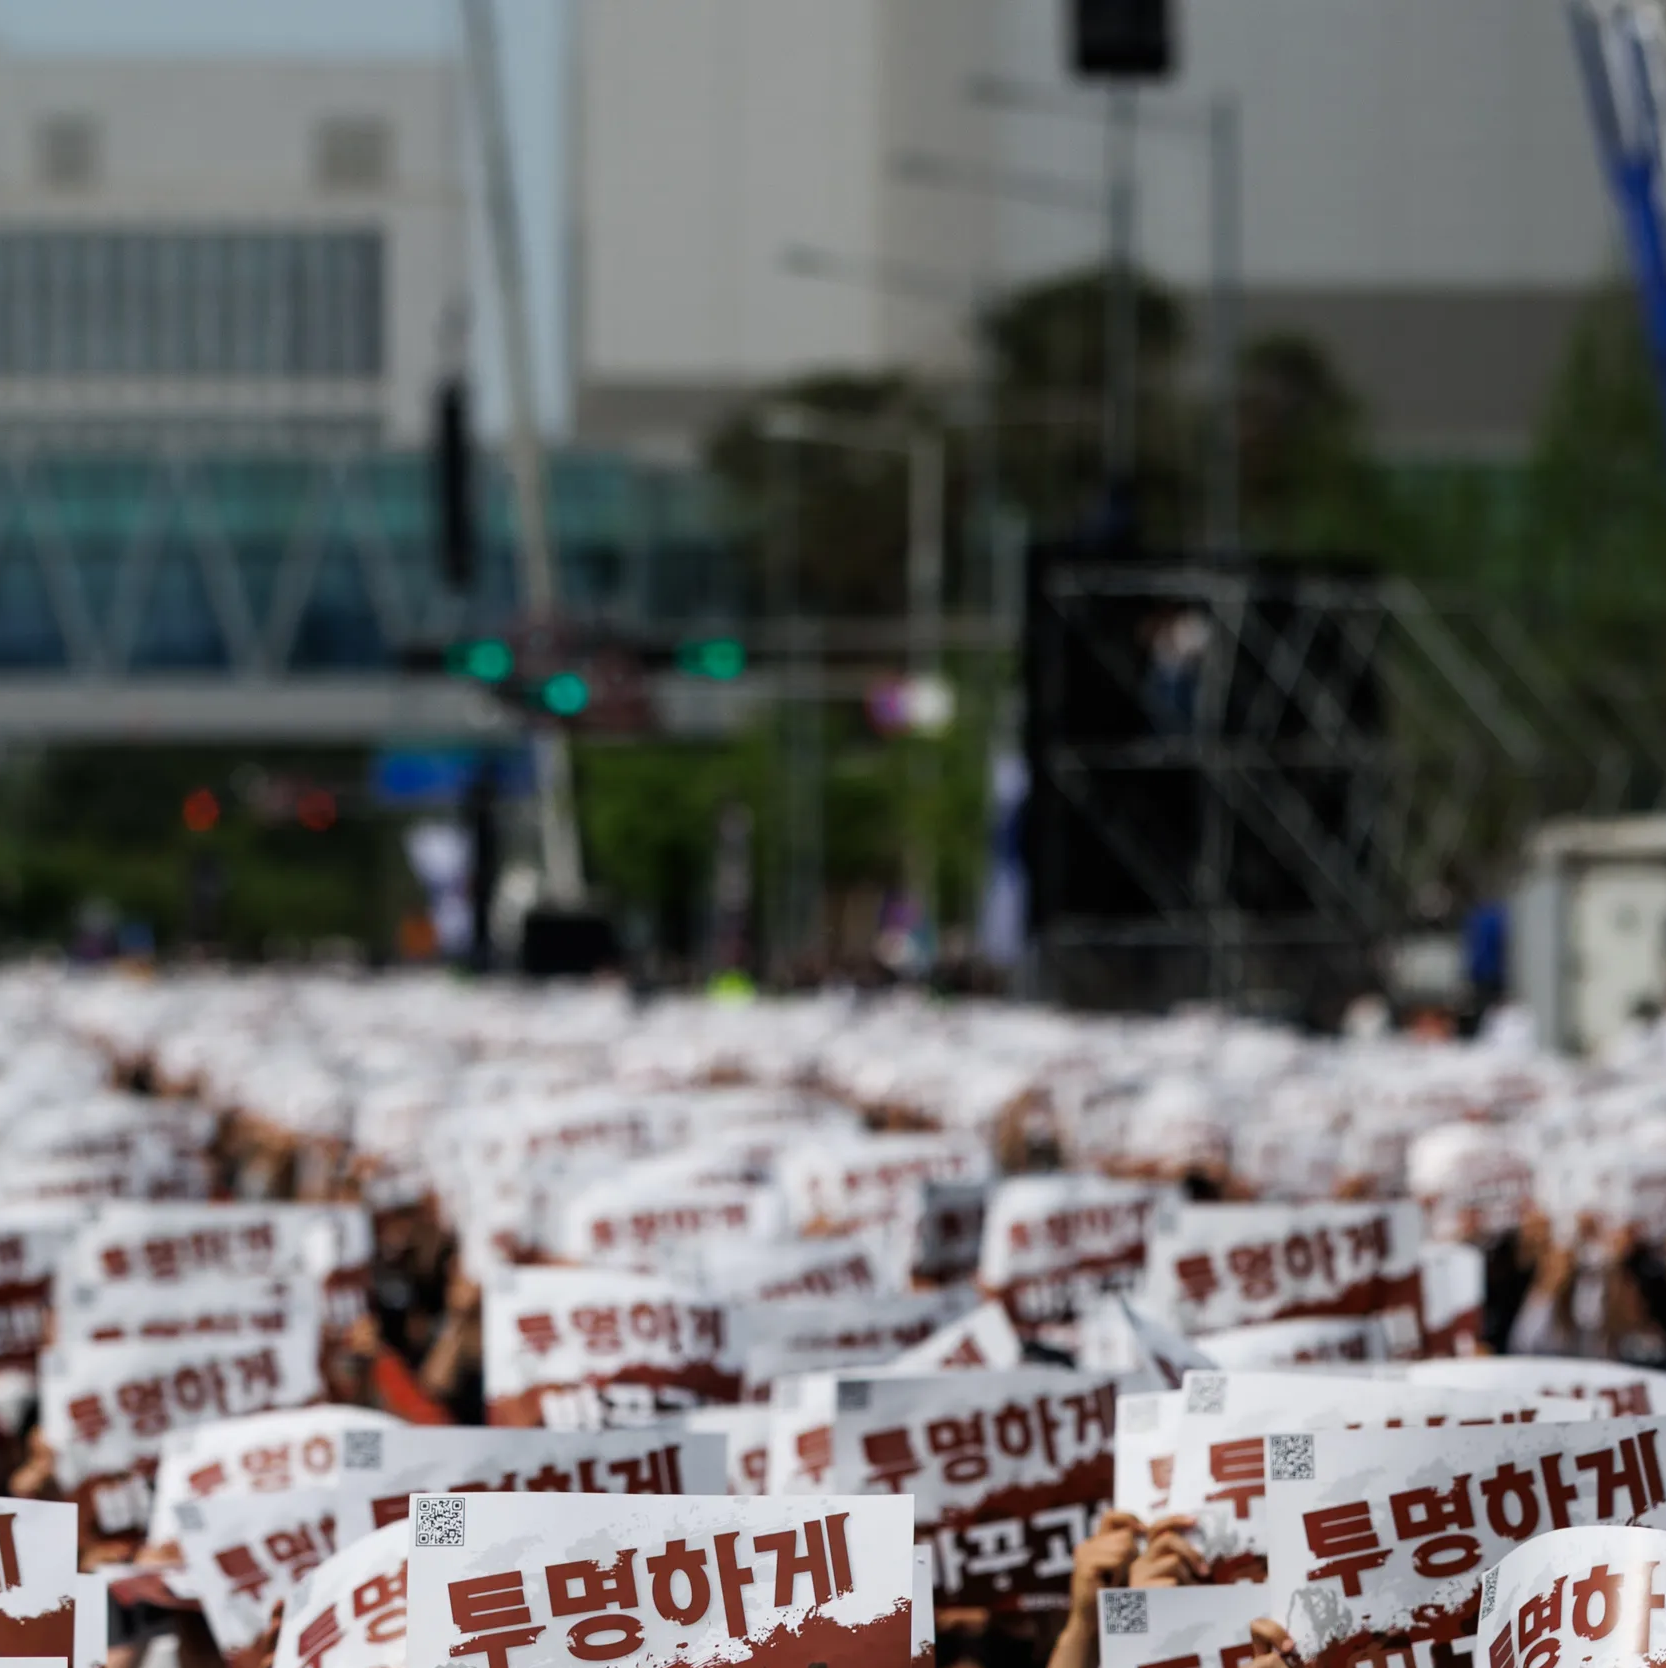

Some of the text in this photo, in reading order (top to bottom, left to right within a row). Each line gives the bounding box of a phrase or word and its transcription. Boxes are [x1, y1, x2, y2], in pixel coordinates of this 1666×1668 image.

[1175, 1213, 1390, 1304] 투명하게
[861, 1384, 1116, 1494] 투명하게
[1303, 1428, 1666, 1598] 투명하게
